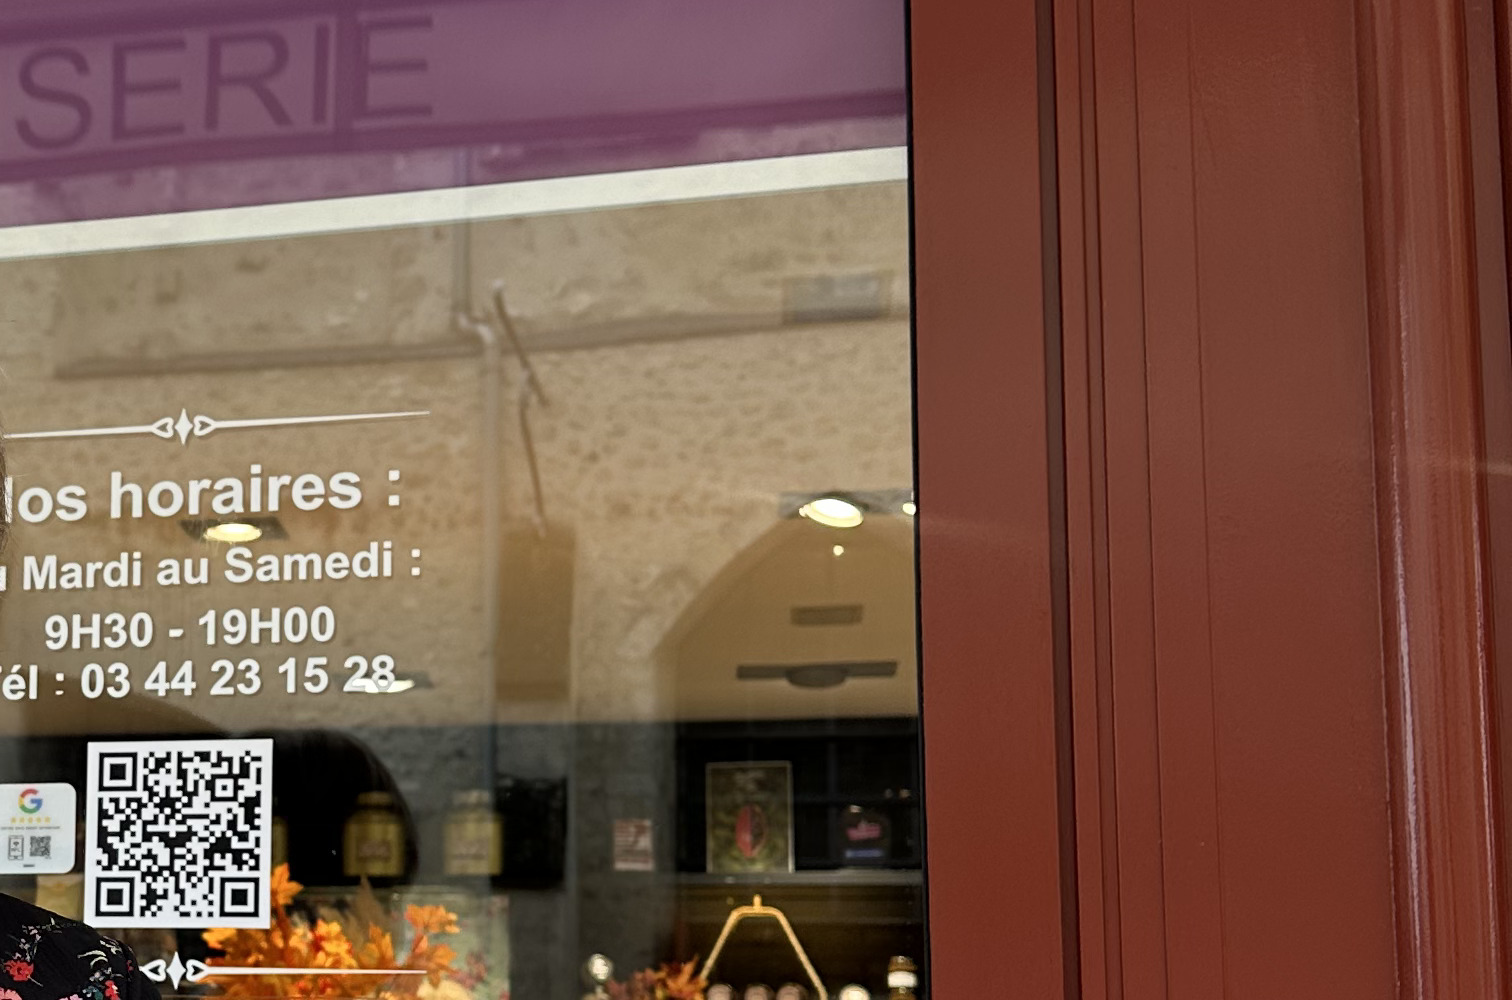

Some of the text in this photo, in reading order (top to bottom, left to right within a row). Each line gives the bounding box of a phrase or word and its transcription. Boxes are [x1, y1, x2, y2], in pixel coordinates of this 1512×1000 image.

[110, 464, 362, 519] horaires
[388, 468, 401, 507] :
[23, 551, 142, 592] Mardi
[157, 557, 210, 586] au
[224, 541, 394, 585] Samedi
[410, 548, 421, 577] :
[44, 606, 336, 651] 9H30 - 19H00
[55, 672, 65, 696] :
[80, 662, 132, 699] 03
[144, 660, 196, 697] 44
[209, 658, 262, 697] 23
[278, 656, 329, 694] 15
[342, 654, 397, 694] 28
